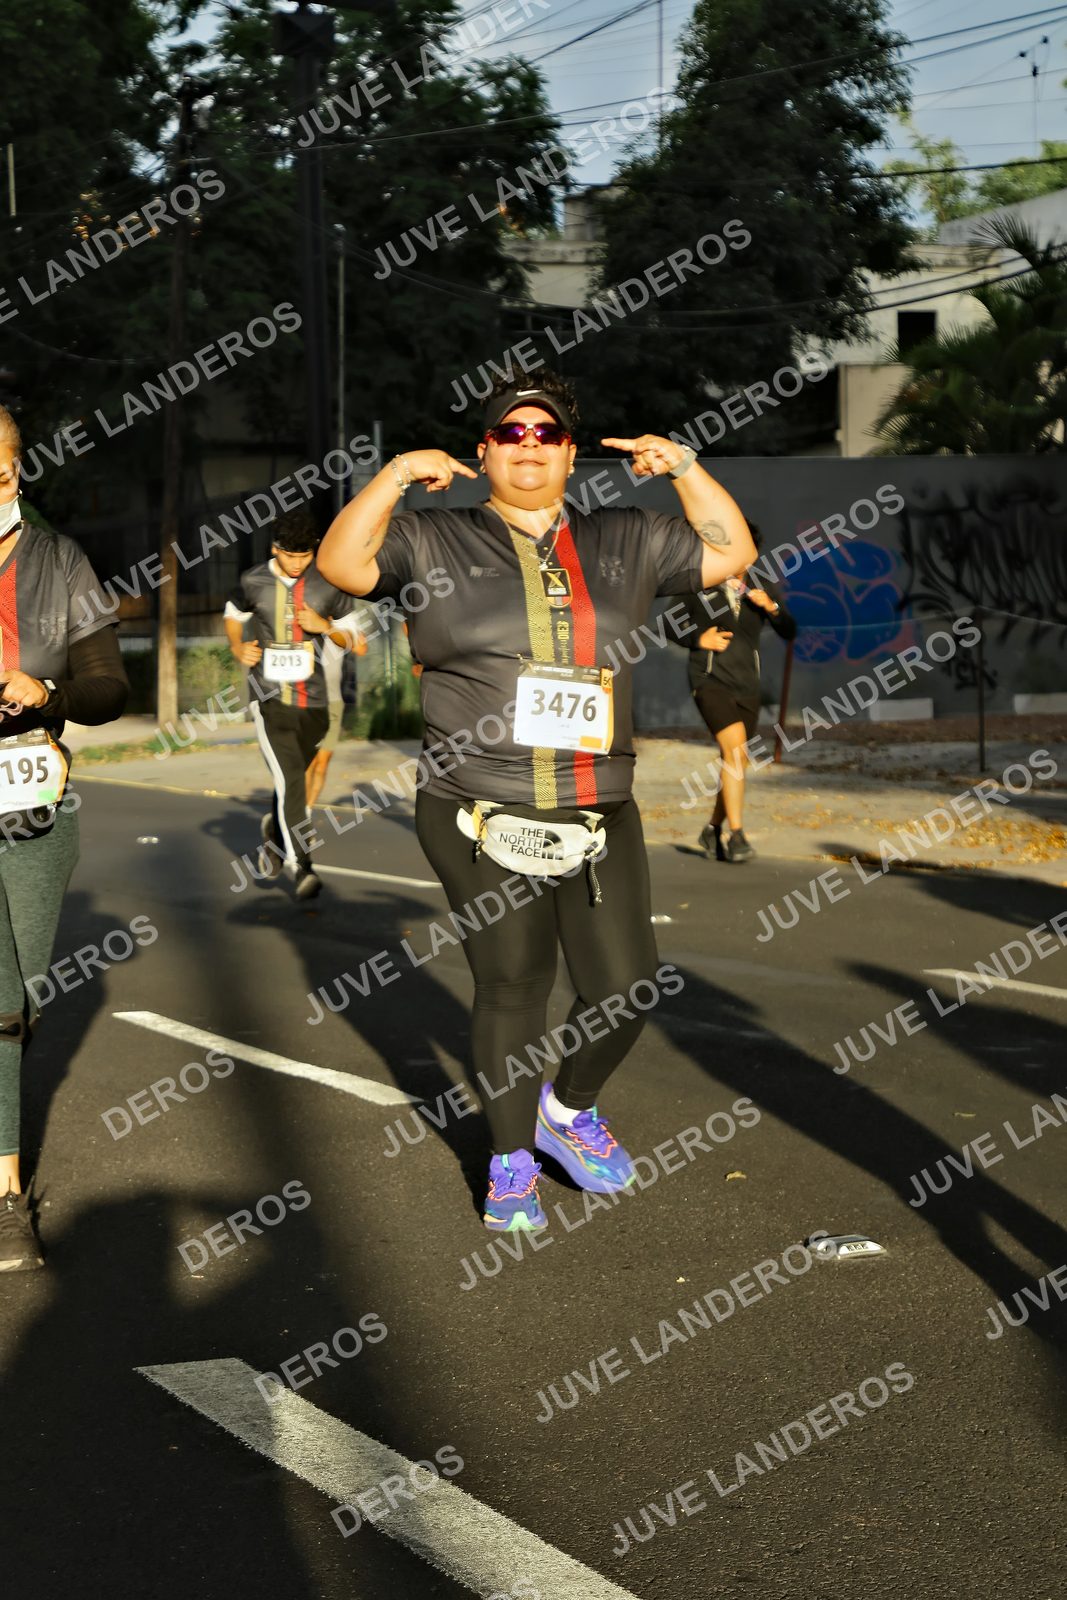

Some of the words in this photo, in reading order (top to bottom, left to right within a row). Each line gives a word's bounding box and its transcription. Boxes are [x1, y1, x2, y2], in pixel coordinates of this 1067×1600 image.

[271, 654, 302, 667] 2013
[530, 689, 597, 722] 3476
[520, 827, 544, 838] THE
[499, 833, 543, 849] NORTH
[511, 845, 542, 858] FACE
